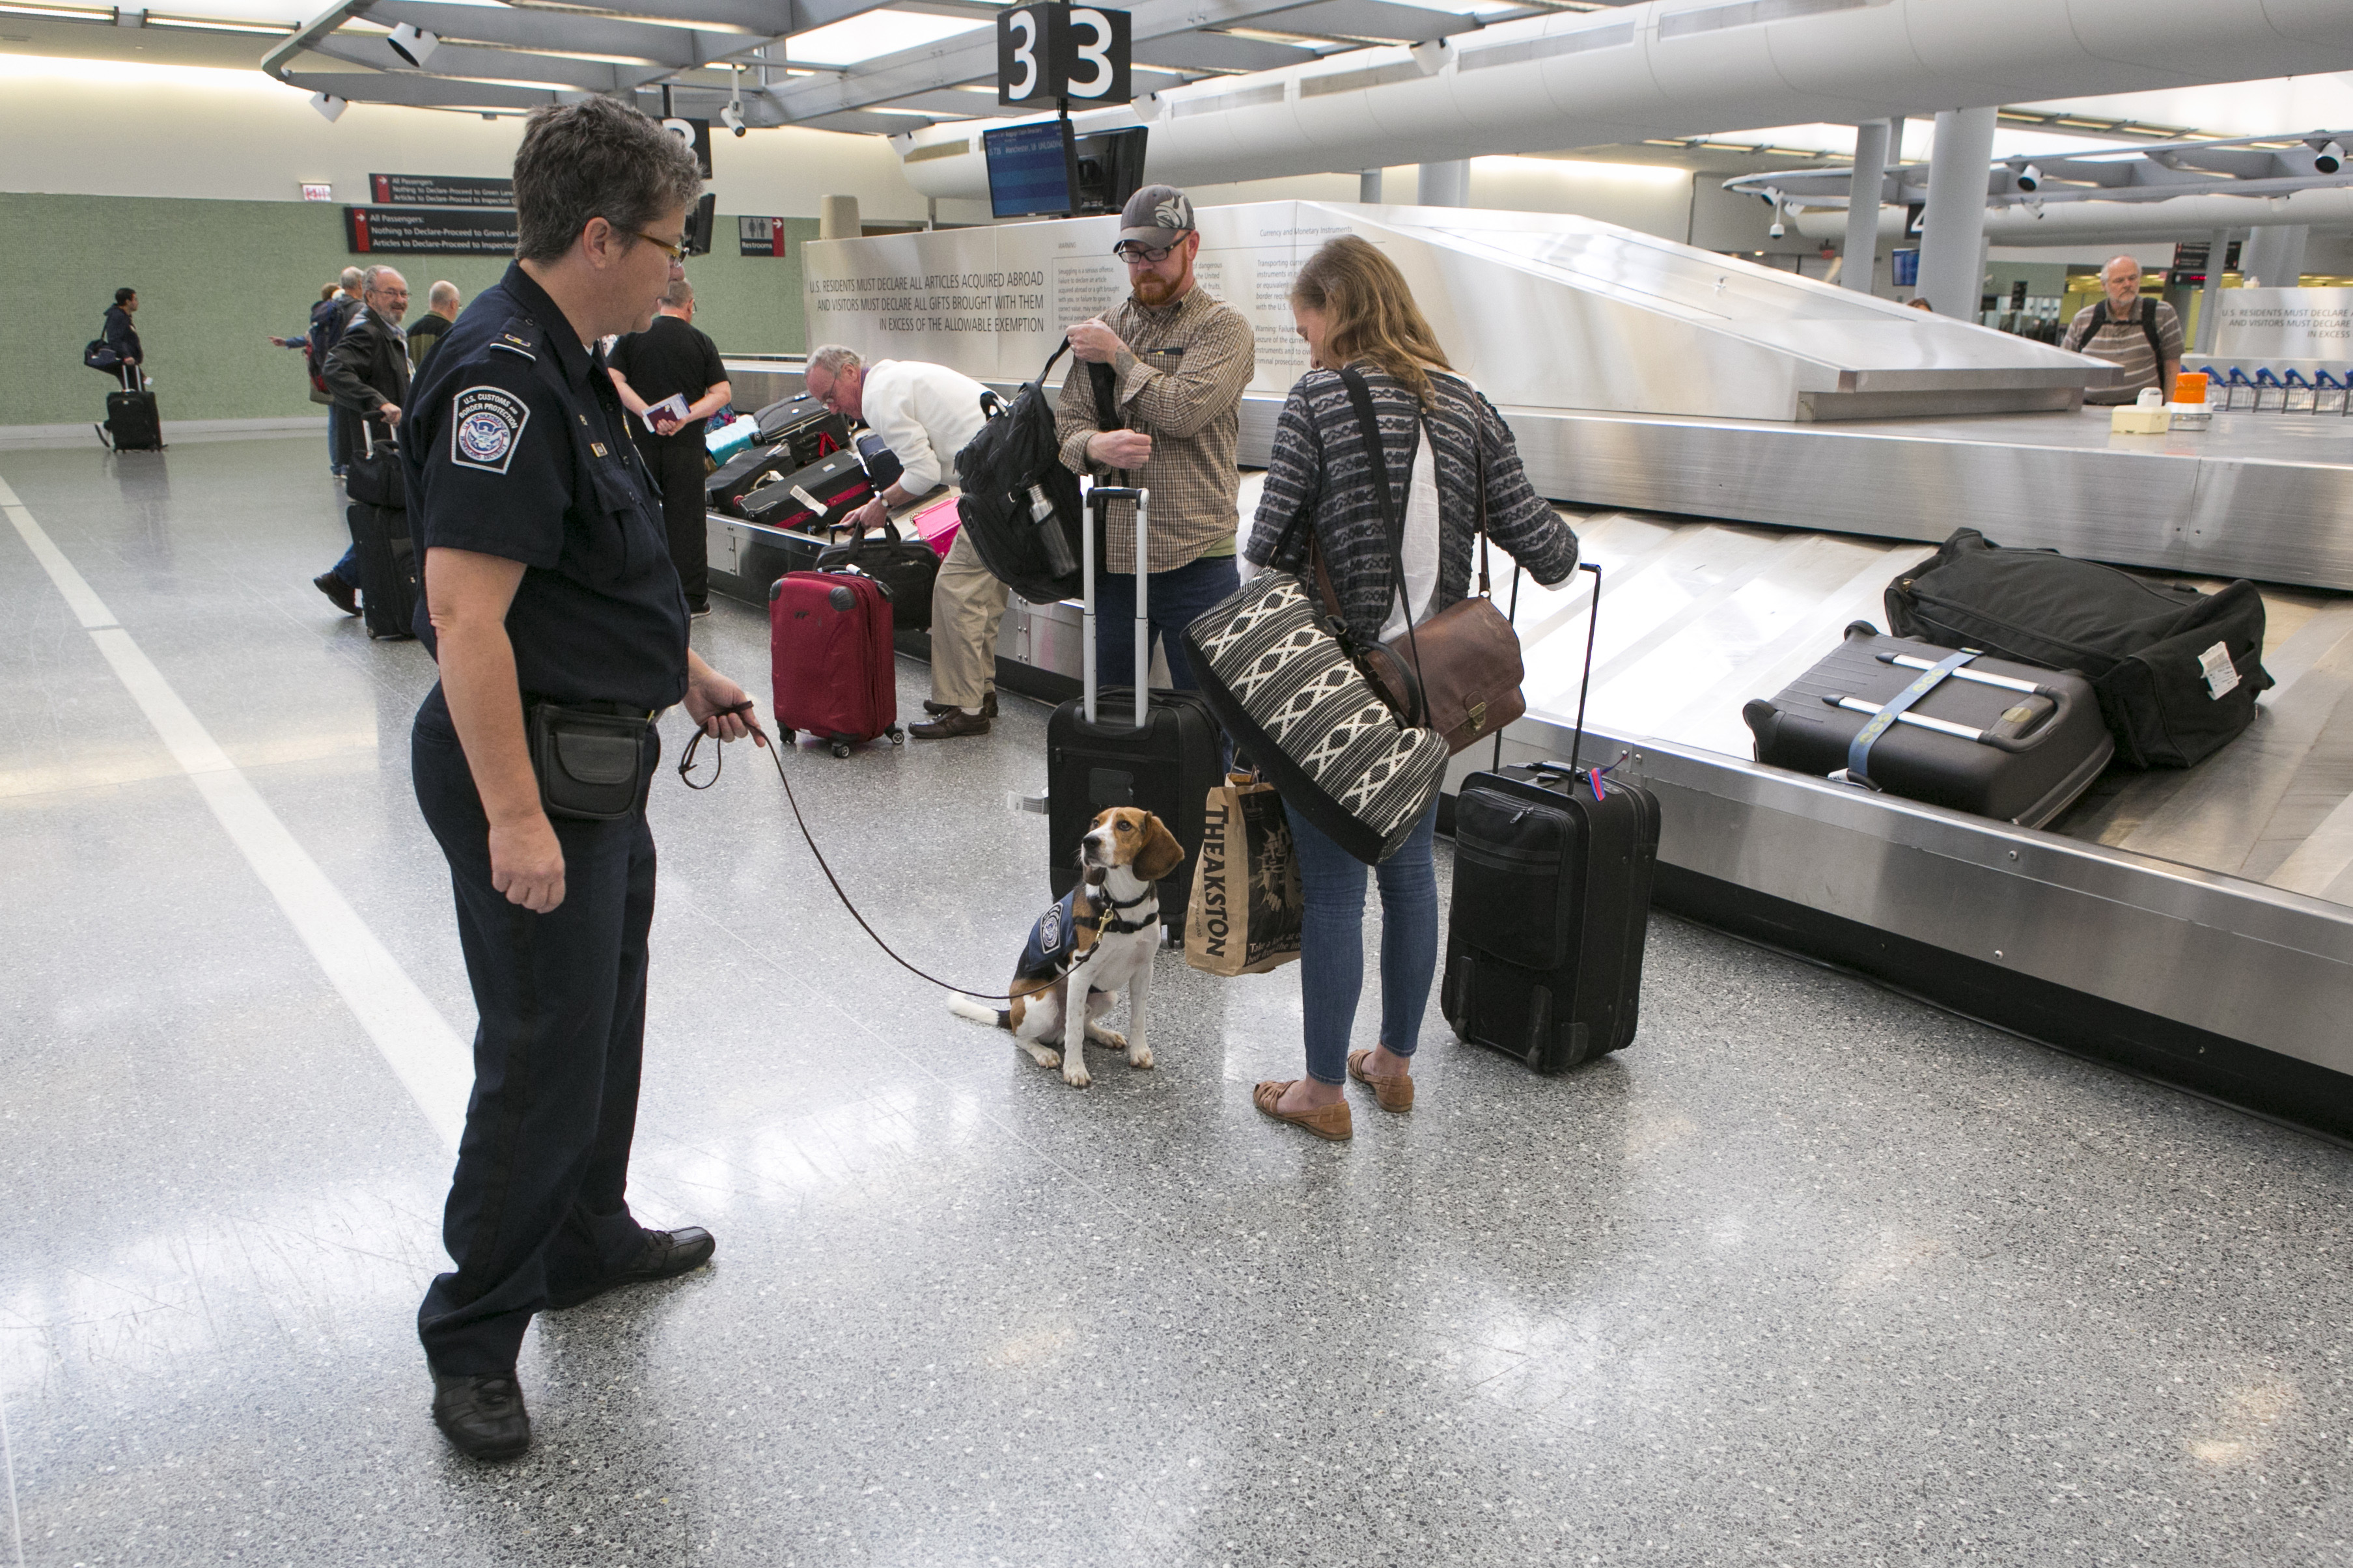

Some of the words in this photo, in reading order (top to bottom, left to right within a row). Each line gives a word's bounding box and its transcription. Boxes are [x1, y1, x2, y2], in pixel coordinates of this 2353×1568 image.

[1009, 10, 1037, 100] 3
[1068, 8, 1113, 98] 3
[370, 213, 381, 222] All
[371, 227, 402, 236] Nothing
[414, 228, 473, 237] Declare-Proceed
[1260, 229, 1282, 240] Currency
[1294, 227, 1319, 237] Monetary
[1199, 262, 1223, 271] dangerous
[1257, 260, 1288, 268] Transporting
[1058, 268, 1078, 276] Smuggling
[810, 281, 822, 293] U.S.
[822, 279, 855, 292] RESIDENTS
[857, 278, 876, 292] MUST
[878, 277, 908, 291] DECLARE
[910, 276, 923, 290] ALL
[925, 274, 960, 290] ARTICLES
[961, 273, 1004, 290] ACQUIRED
[1007, 271, 1044, 287] ABROAD
[1263, 281, 1289, 290] equivalent
[1104, 285, 1120, 294] brought
[817, 298, 830, 312] AND
[831, 297, 859, 311] VISITORS
[861, 297, 880, 311] MUST
[882, 297, 912, 311] DECLARE
[914, 296, 927, 310] ALL
[929, 296, 951, 310] GIFTS
[953, 295, 992, 310] BROUGHT
[994, 294, 1016, 310] WITH
[1018, 294, 1044, 310] THEM
[880, 318, 887, 331] IN
[889, 317, 914, 331] EXCESS
[916, 317, 926, 331] OF
[928, 317, 942, 331] THE
[944, 317, 992, 332] ALLOWABLE
[994, 317, 1044, 332] EXEMPTION
[1255, 325, 1276, 334] Warning:
[463, 395, 476, 405] U.S.
[478, 393, 511, 407] CUSTOMS
[458, 403, 483, 419] BORDER
[484, 403, 519, 429] PROTECTION
[1204, 805, 1229, 958] THEAKSTON
